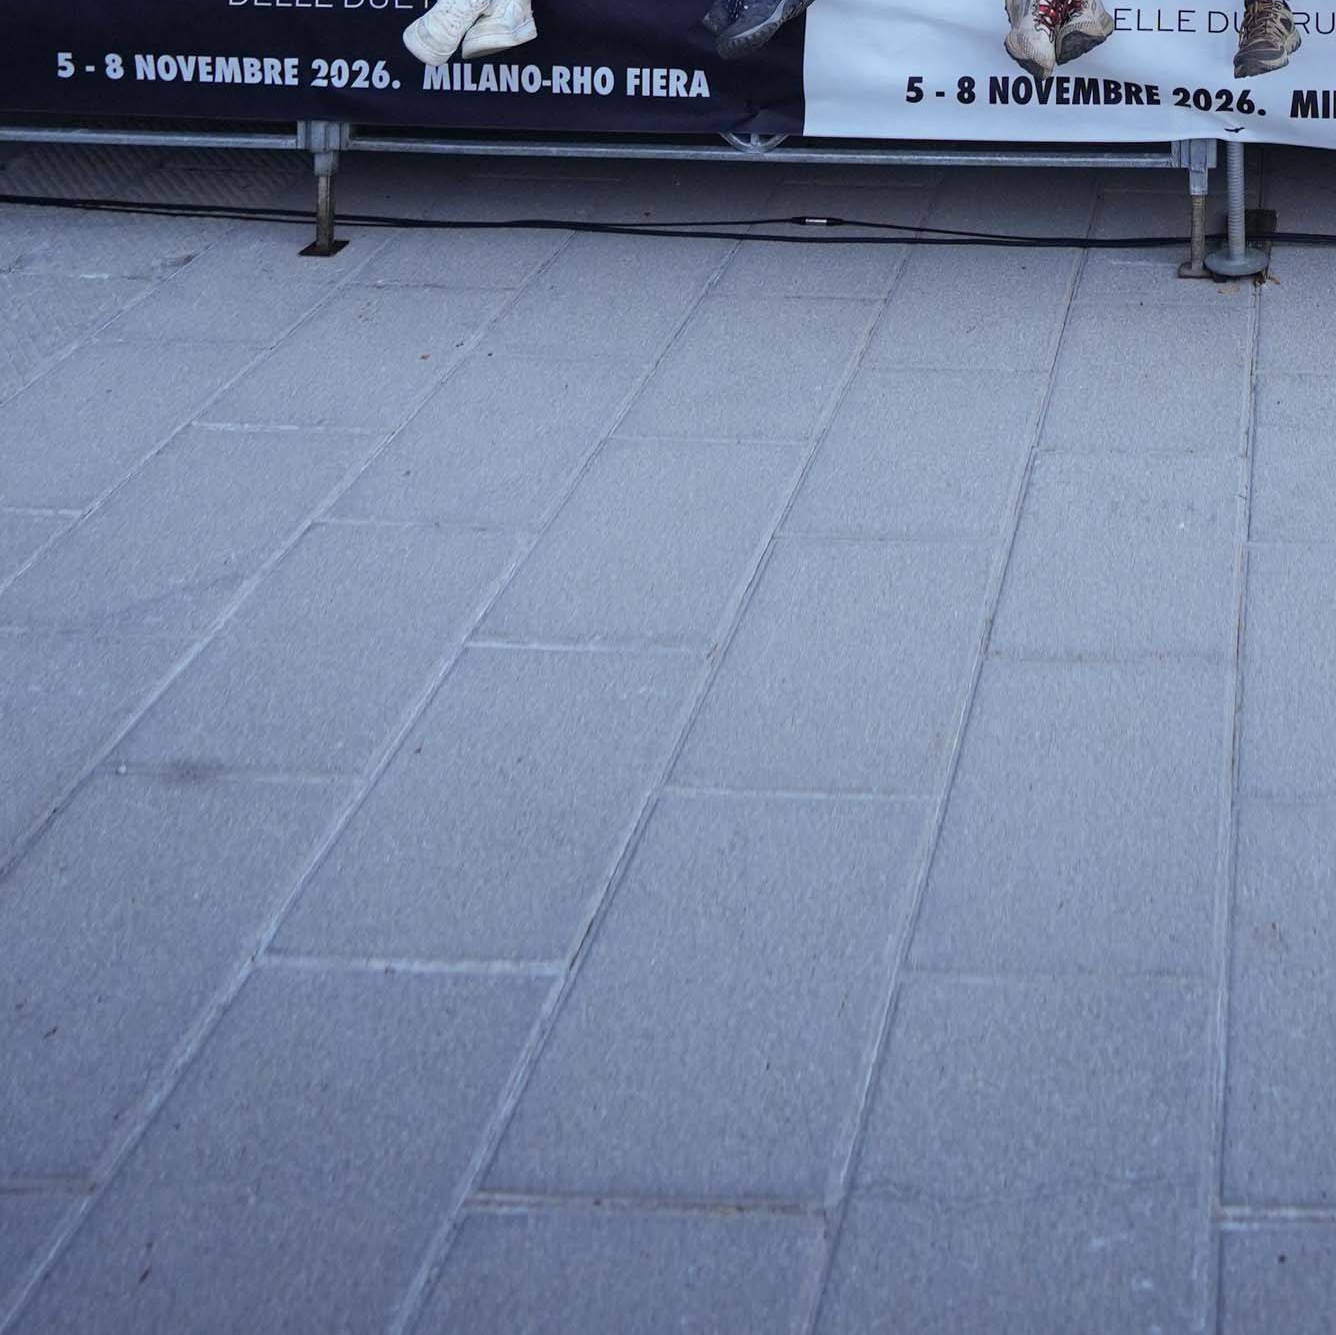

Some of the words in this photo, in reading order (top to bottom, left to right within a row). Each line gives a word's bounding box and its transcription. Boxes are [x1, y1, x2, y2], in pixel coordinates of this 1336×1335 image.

[1114, 8, 1197, 33] ELLE
[57, 52, 75, 79] 5
[105, 53, 125, 80] 8
[135, 54, 299, 86] NOVEMBRE
[310, 59, 401, 89] 2026.
[422, 64, 615, 97] MILANO-RHO
[626, 67, 711, 98] FIERA
[906, 75, 924, 103] 5
[956, 75, 976, 105] 8
[989, 75, 1161, 107] NOVEMBRE
[1172, 87, 1267, 117] 2026.
